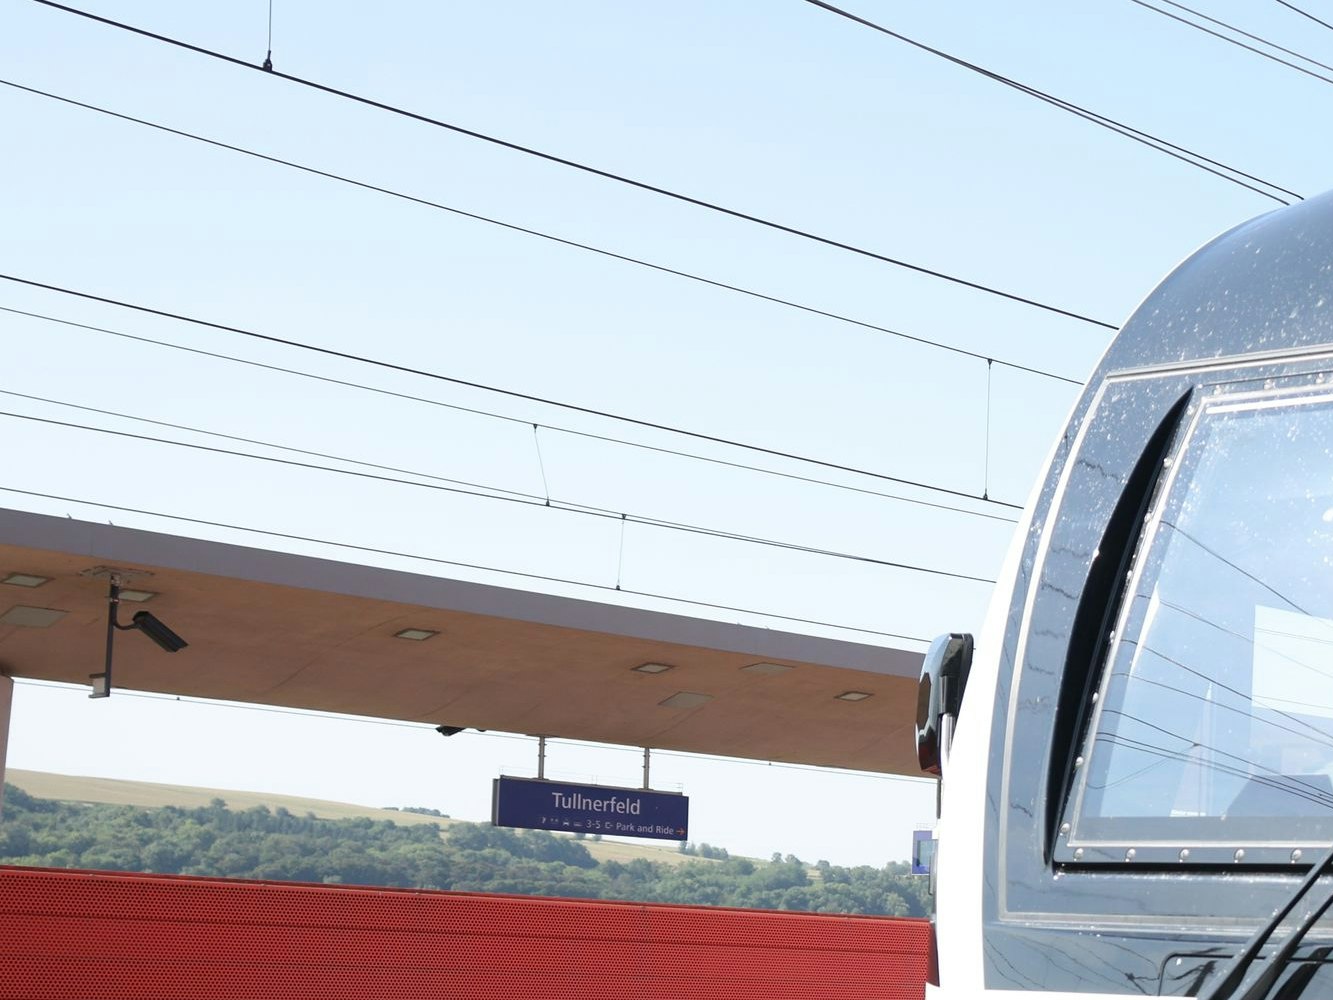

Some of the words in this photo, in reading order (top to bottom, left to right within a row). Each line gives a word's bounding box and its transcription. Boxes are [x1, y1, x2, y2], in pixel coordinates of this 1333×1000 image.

[552, 792, 641, 815] Tullnerfeld
[586, 819, 601, 830] 3-5
[616, 822, 635, 833] Park
[637, 824, 654, 835] and
[655, 825, 675, 836] Ride
